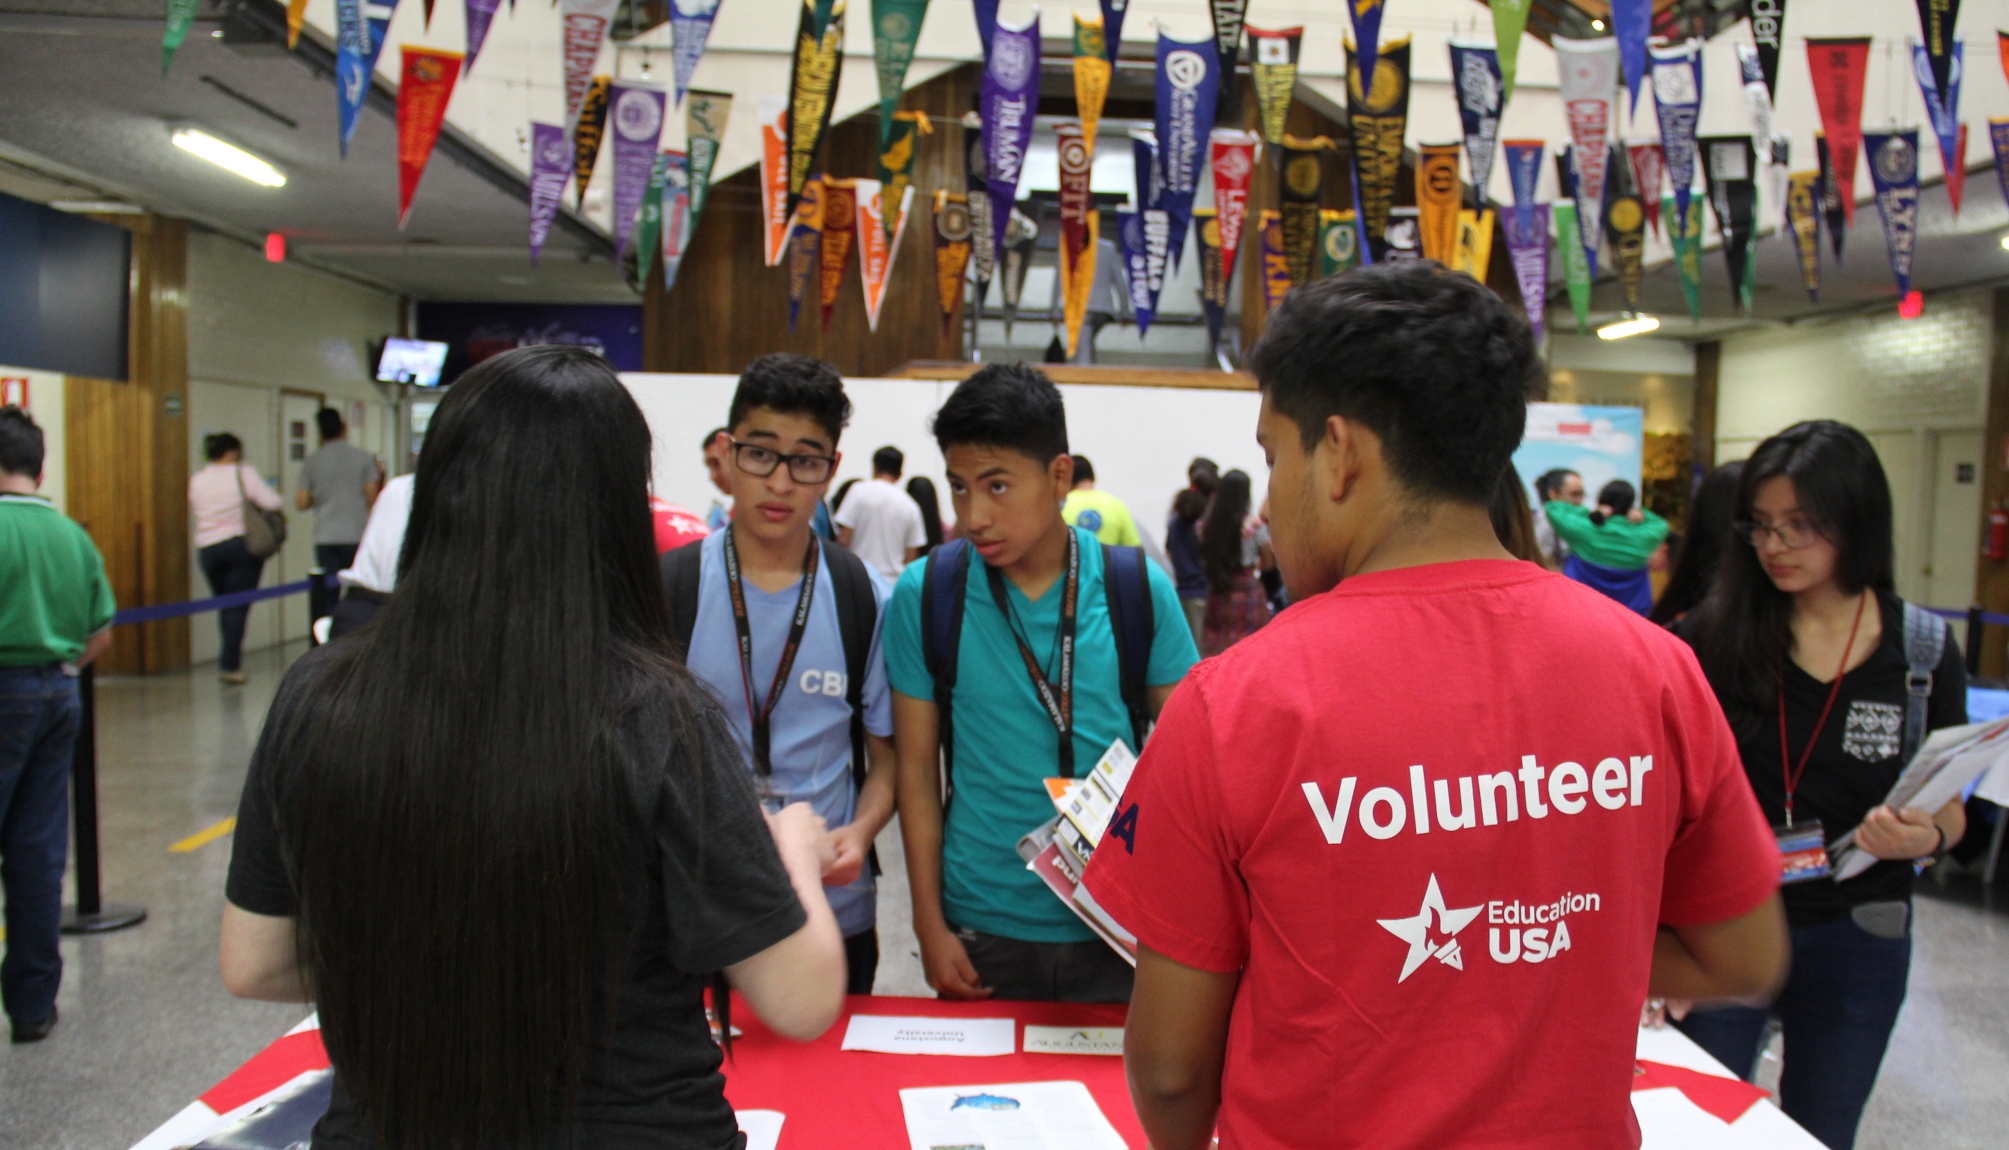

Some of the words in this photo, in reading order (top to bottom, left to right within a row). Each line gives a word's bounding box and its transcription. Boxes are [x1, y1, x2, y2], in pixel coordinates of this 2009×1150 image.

[565, 13, 606, 116] CHAPMAN
[999, 94, 1026, 185] TRUMAN
[1567, 99, 1609, 198] CHAPMAN
[1060, 173, 1088, 224] FIT
[1144, 209, 1170, 291] BUFFALO
[1061, 635, 1073, 691] KALAMAZOO
[1037, 680, 1067, 732] KALAMAZOO
[1301, 754, 1653, 845] Volunteer
[1488, 891, 1600, 925] Education
[1488, 920, 1572, 964] USA
